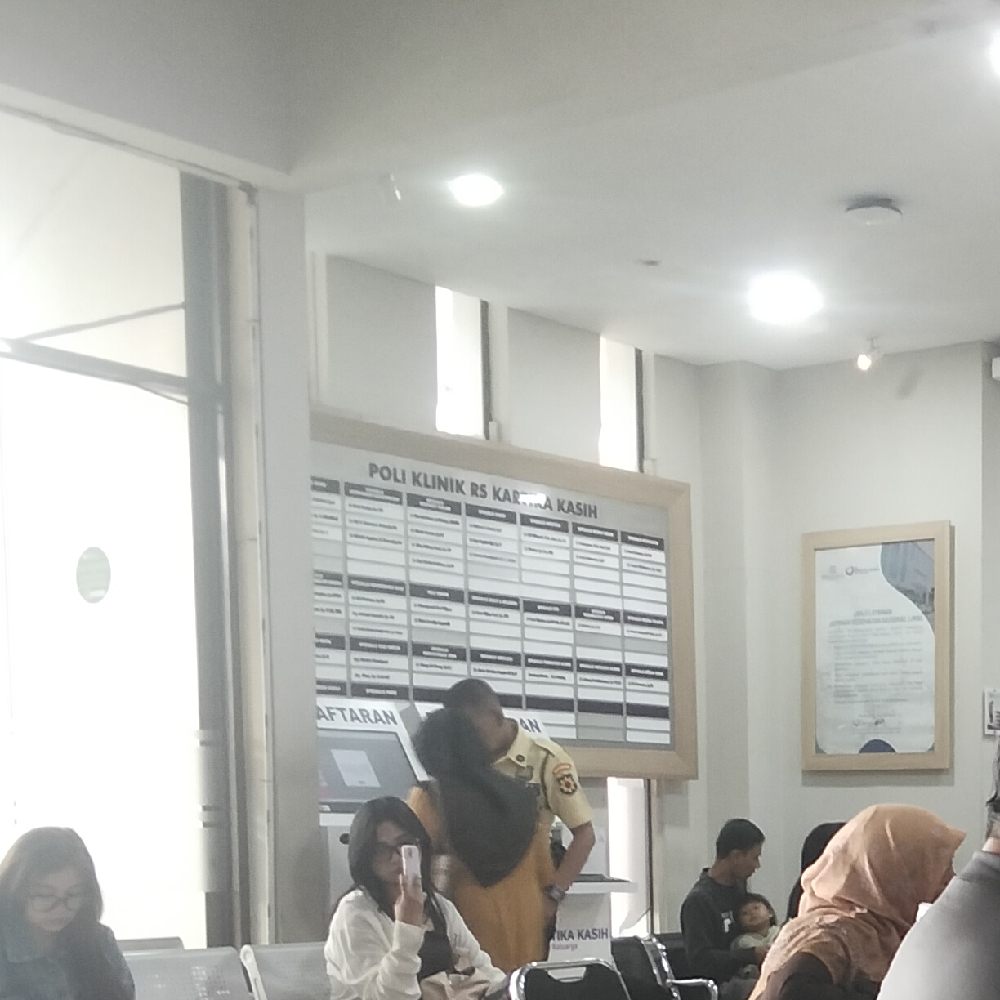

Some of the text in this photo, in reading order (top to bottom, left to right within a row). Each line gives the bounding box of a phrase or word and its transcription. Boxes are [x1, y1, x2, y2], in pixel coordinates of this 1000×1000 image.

[368, 462, 406, 484] POLI
[412, 471, 467, 495] KLINIK
[470, 481, 488, 499] RS
[557, 498, 598, 519] KASIH
[577, 928, 609, 940] KASIH
